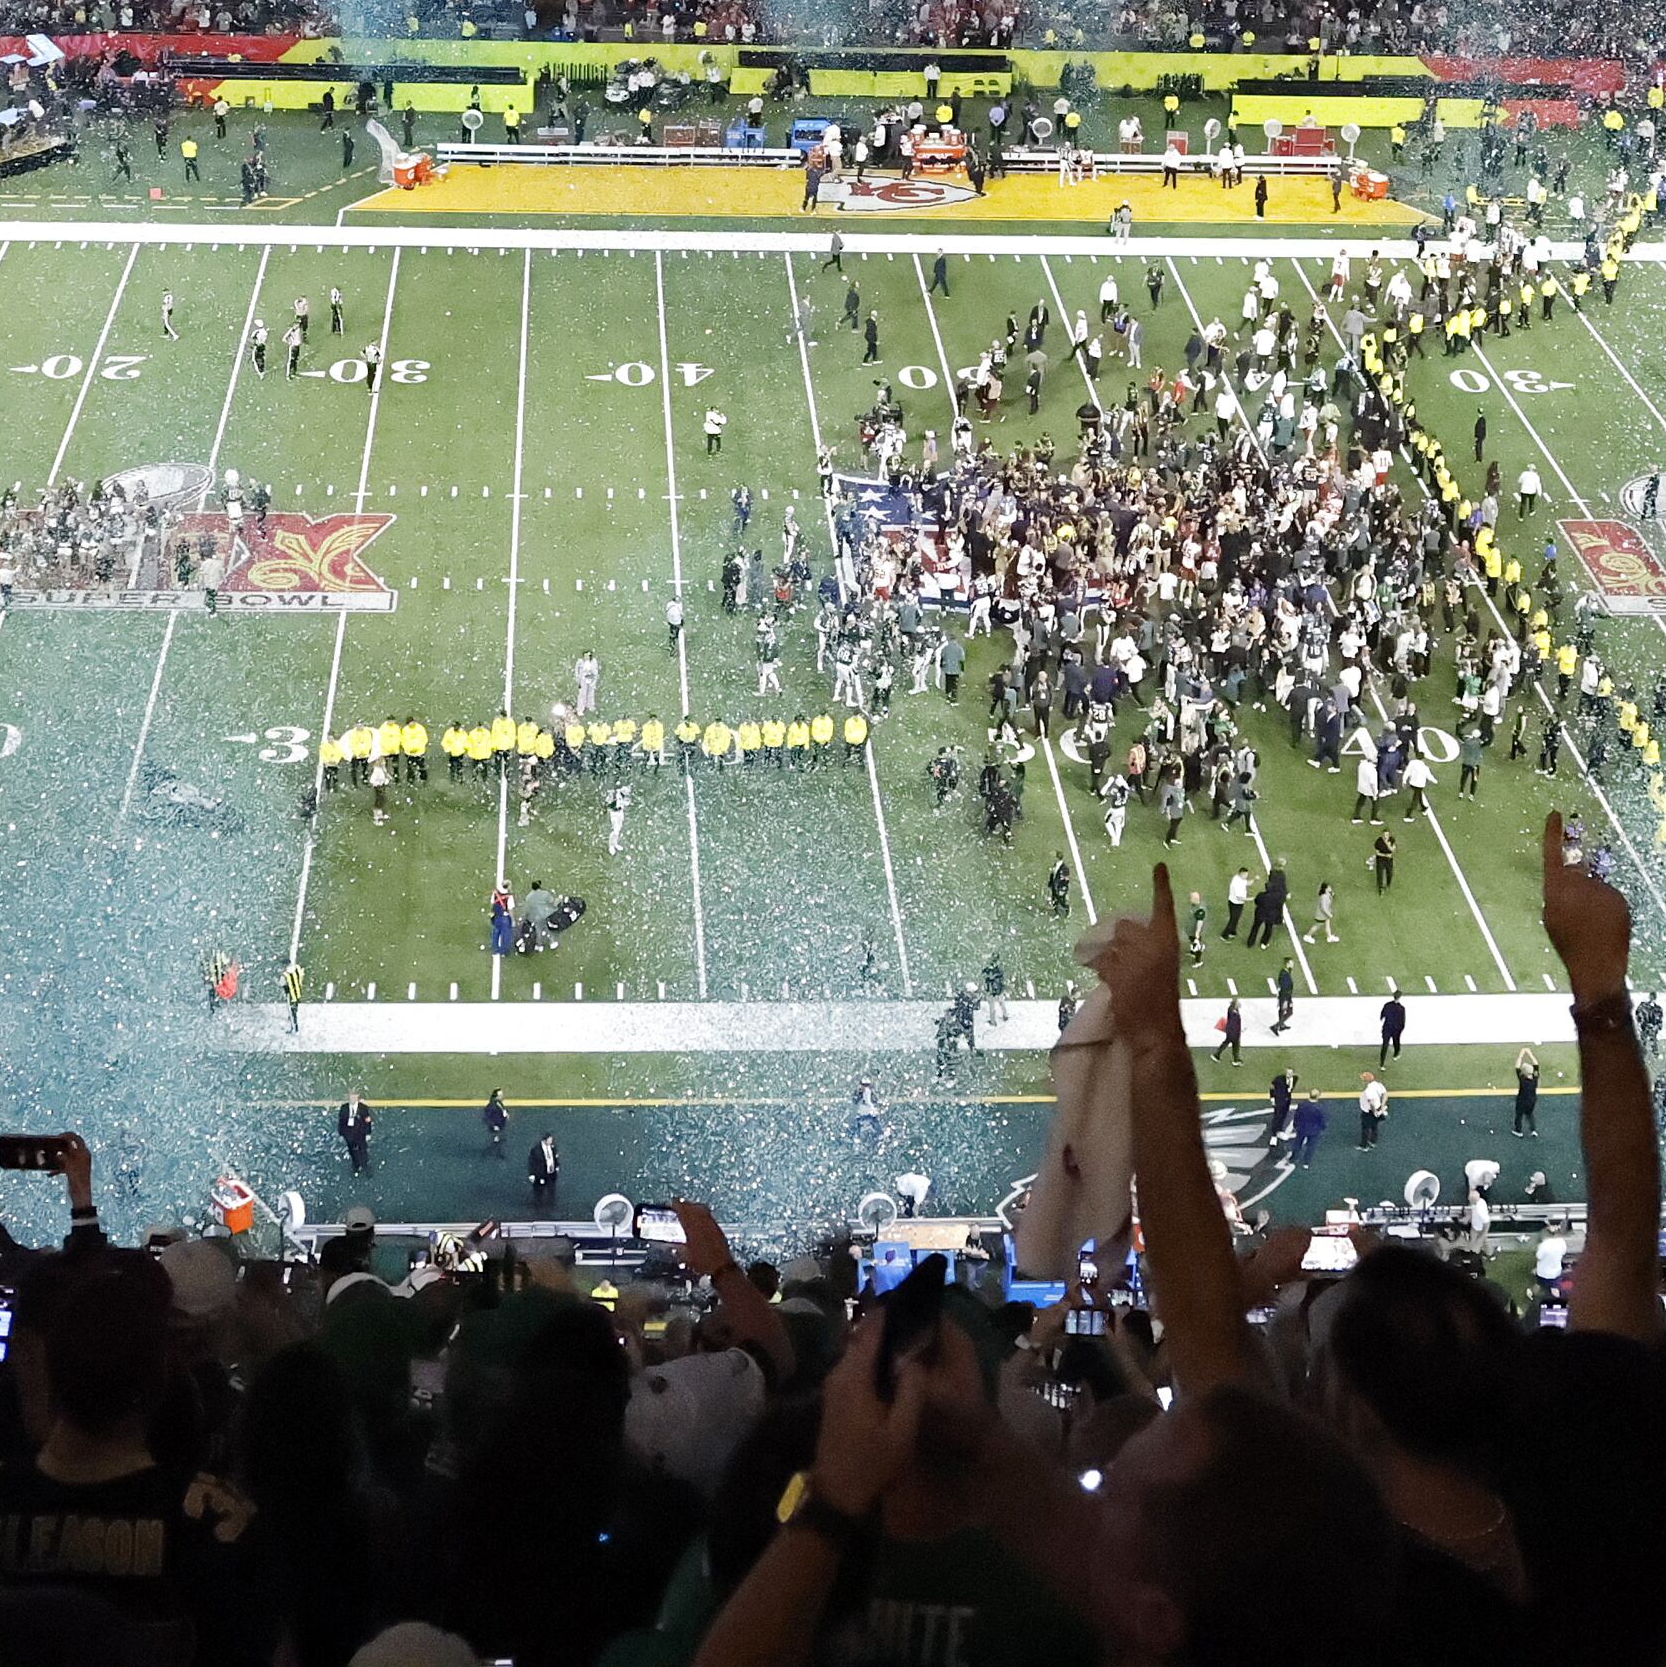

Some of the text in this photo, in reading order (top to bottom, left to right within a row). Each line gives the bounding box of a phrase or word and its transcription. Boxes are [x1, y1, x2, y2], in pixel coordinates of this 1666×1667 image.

[40, 354, 148, 380] 20
[329, 358, 431, 384] 30
[614, 362, 716, 388] 40
[1449, 369, 1550, 393] 30
